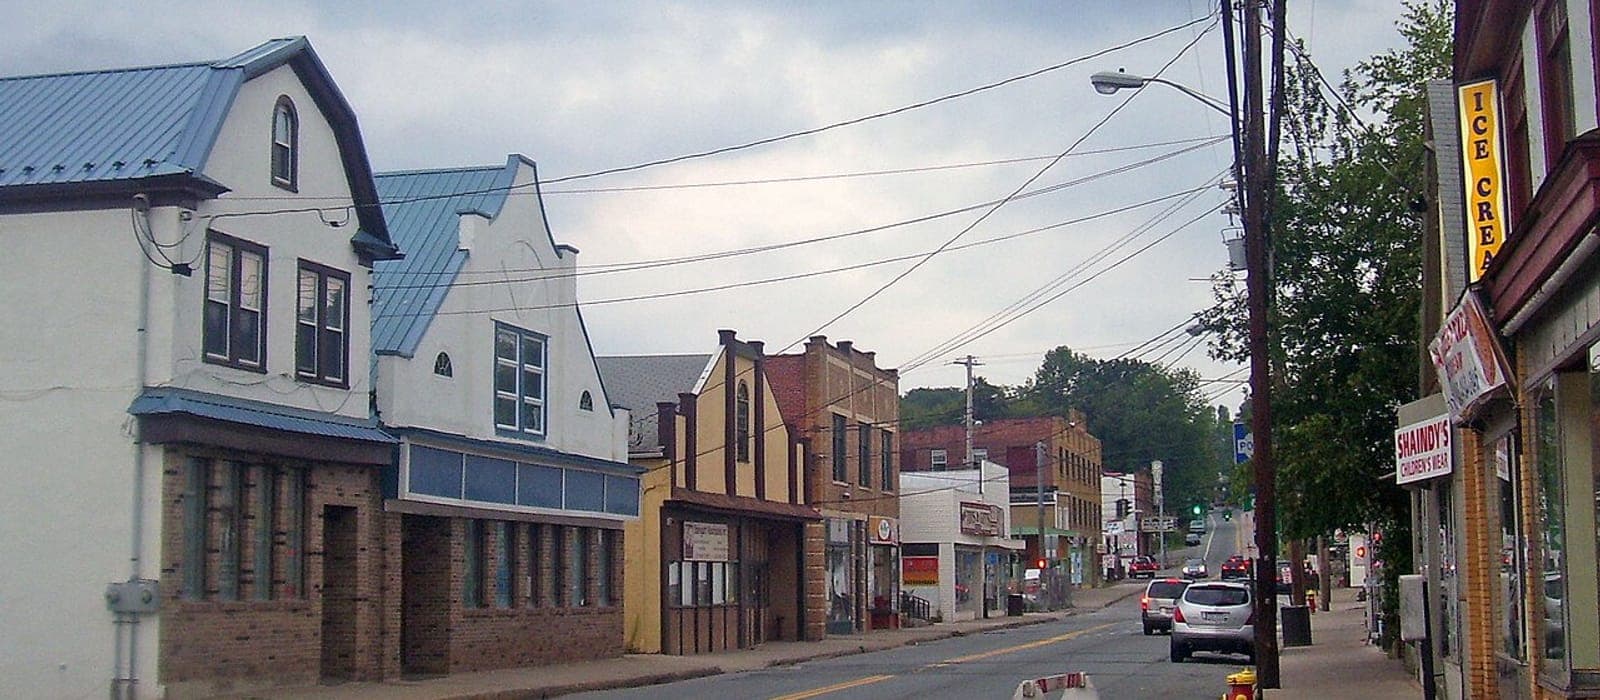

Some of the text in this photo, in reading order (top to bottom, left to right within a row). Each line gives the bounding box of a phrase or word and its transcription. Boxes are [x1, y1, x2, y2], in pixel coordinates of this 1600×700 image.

[1472, 92, 1489, 160] ICE
[1398, 419, 1449, 459] SHAINDY'S
[1401, 452, 1448, 477] CHILDREN'S WEAR
